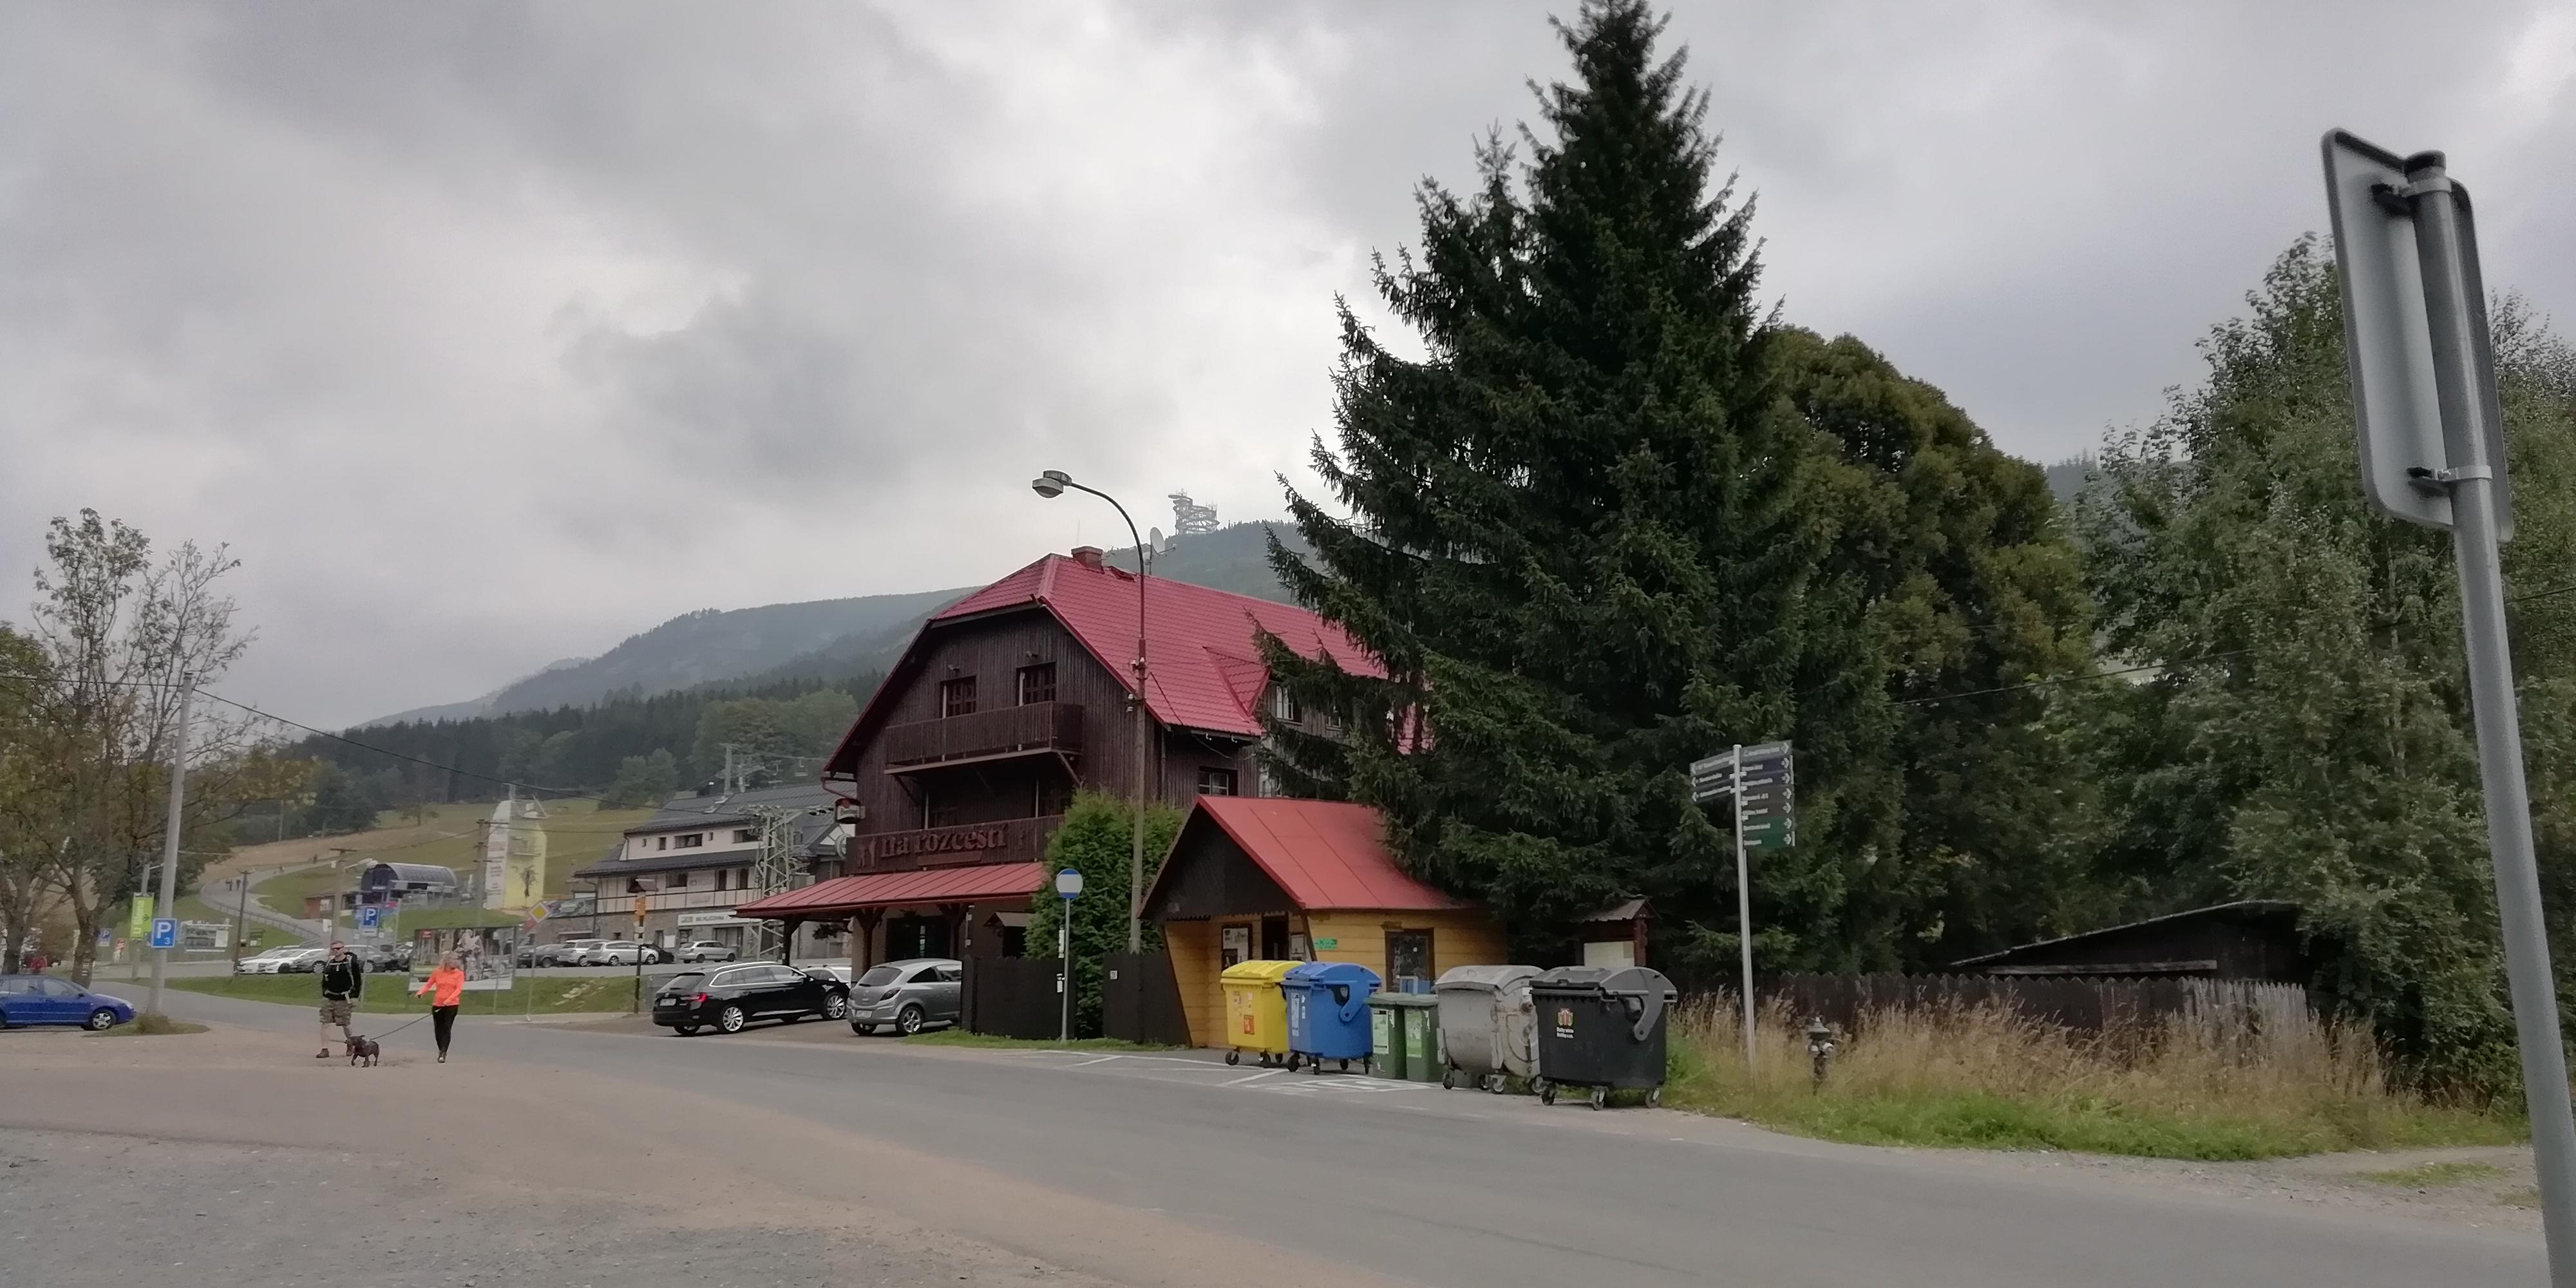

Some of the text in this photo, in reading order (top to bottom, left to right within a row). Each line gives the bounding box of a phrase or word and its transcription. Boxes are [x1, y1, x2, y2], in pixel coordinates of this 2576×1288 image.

[880, 823, 1009, 857] na rozcestí
[156, 922, 171, 938] P
